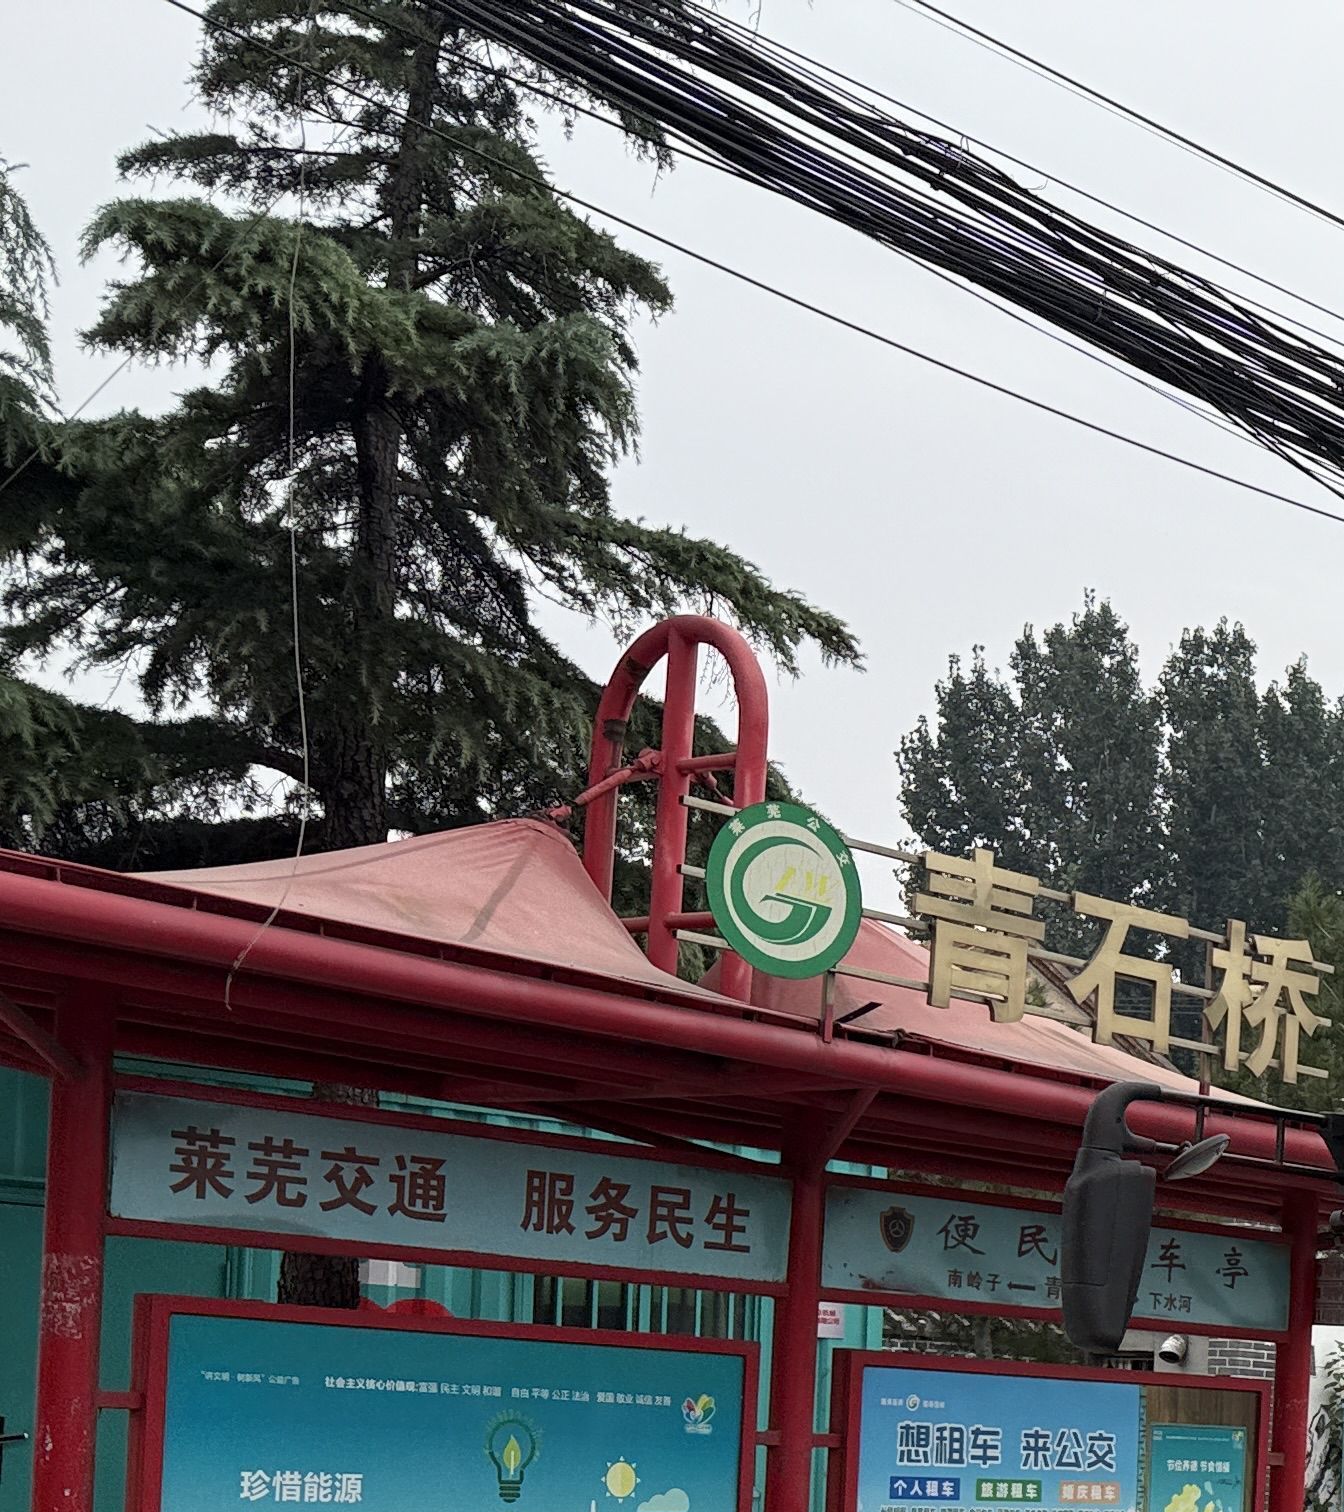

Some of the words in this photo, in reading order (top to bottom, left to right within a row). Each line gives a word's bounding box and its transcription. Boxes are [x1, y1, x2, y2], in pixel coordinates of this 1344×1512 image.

[912, 848, 1324, 1084] 青石桥
[168, 1125, 448, 1224] 莱芜交通
[520, 1169, 752, 1254] 服务民生
[947, 1268, 1002, 1293] 南岭子
[1149, 1292, 1192, 1314] 下水河
[898, 1423, 1001, 1466] 想租车
[1021, 1429, 1116, 1470] 来公交
[239, 1470, 364, 1504] 珍惜能源
[893, 1479, 955, 1497] 个人租车
[980, 1482, 1039, 1499] 旅游租车
[1062, 1484, 1116, 1501] 婚庆租车
